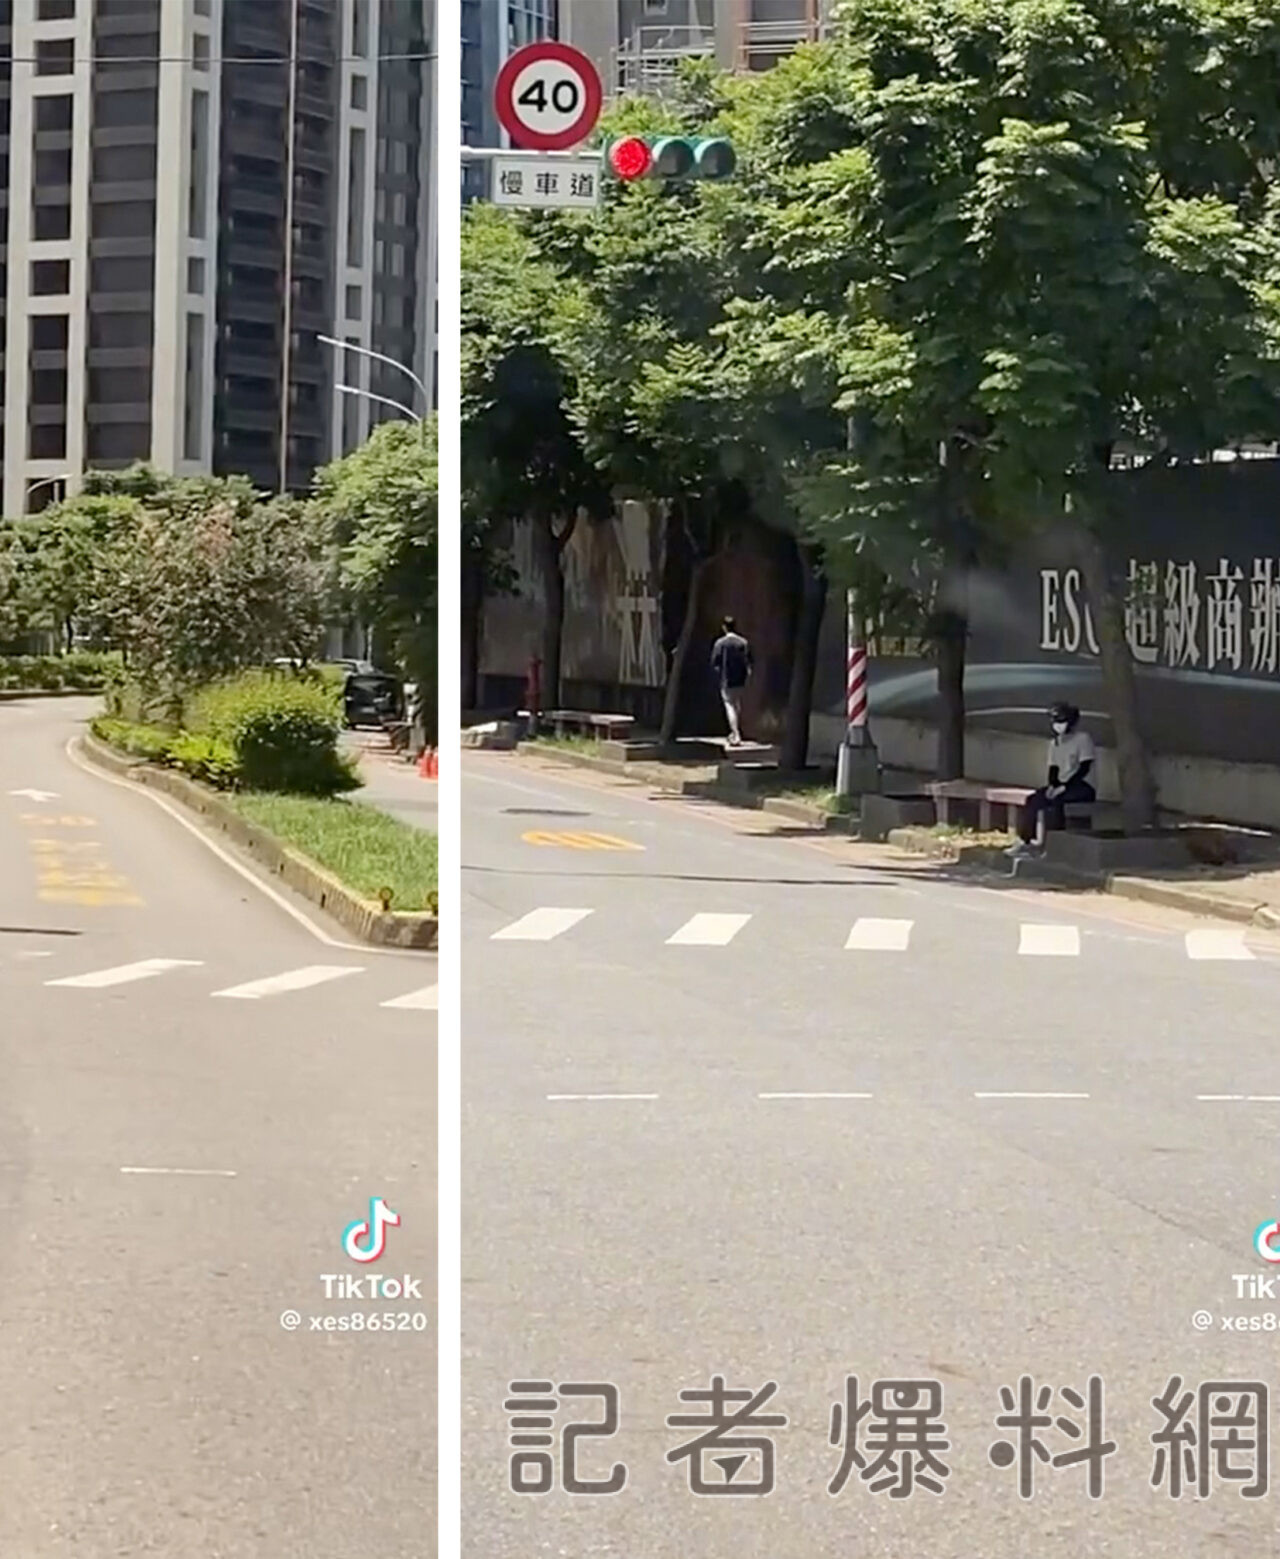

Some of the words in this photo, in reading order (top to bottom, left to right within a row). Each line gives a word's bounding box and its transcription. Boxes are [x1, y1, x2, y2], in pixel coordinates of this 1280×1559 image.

[518, 79, 578, 114] 40
[499, 170, 594, 197] 慢車道
